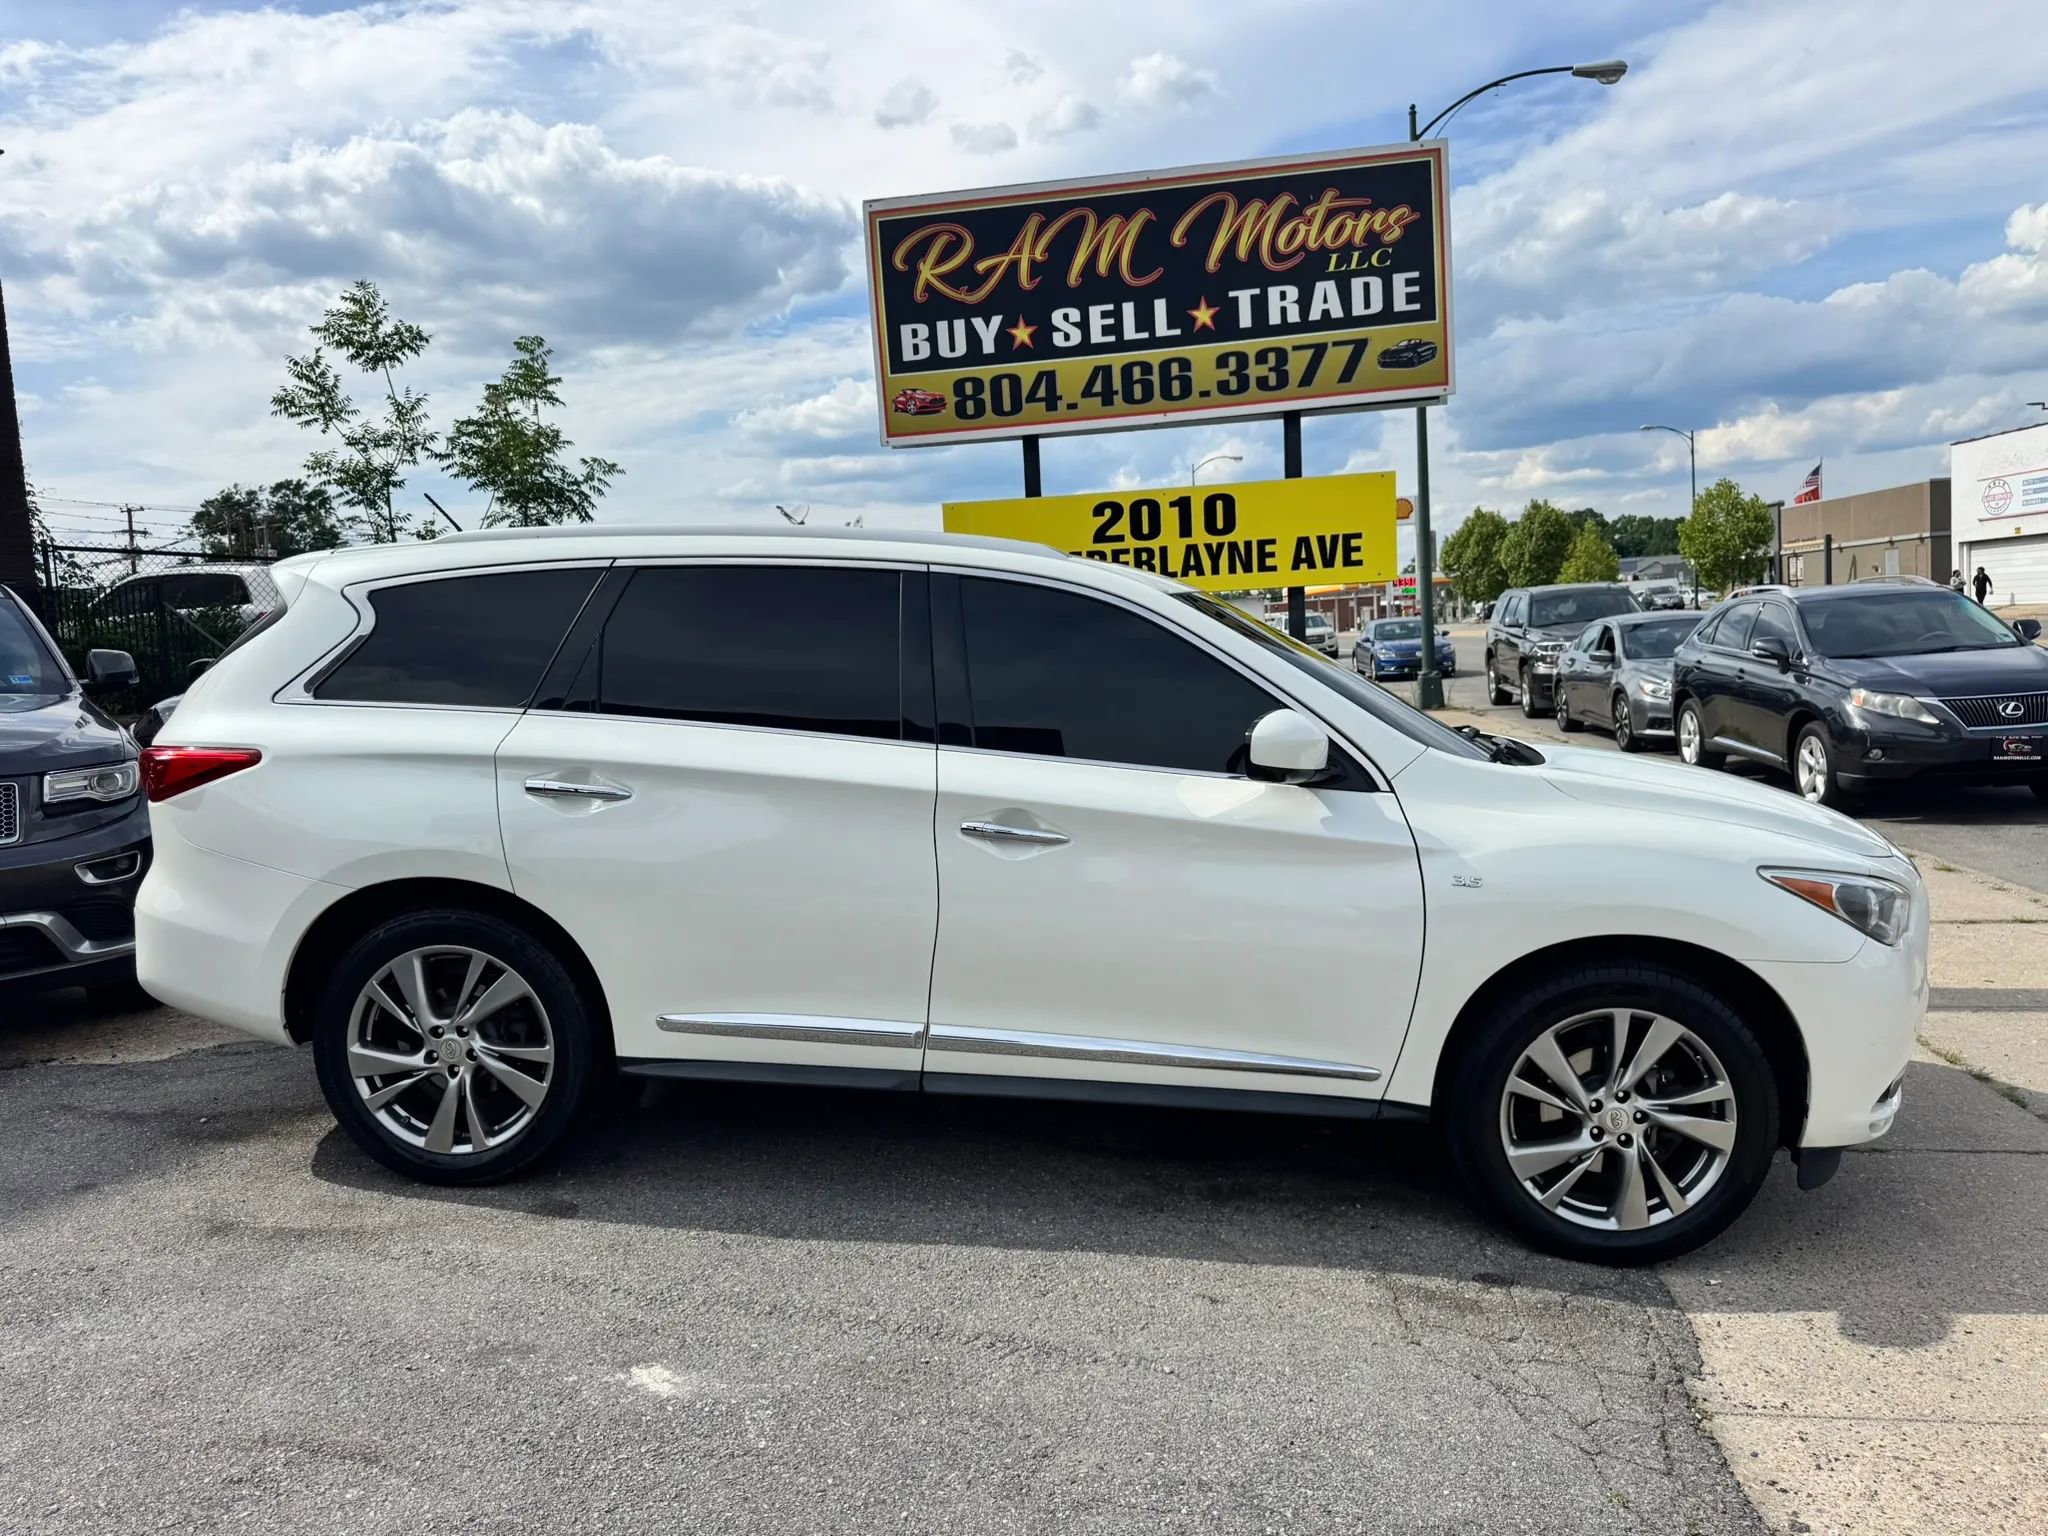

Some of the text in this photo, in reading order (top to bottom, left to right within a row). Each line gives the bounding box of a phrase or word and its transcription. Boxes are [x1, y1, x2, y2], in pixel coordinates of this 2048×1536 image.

[892, 187, 1420, 304] RAM Motors
[1324, 247, 1393, 273] LLC
[900, 270, 1422, 362] BUY SELL TRADE
[952, 337, 1370, 421] 804.466.3377
[1092, 493, 1237, 544] 2010
[1069, 532, 1364, 578] ERLAYNE AVE
[1452, 876, 1482, 888] 3.5
